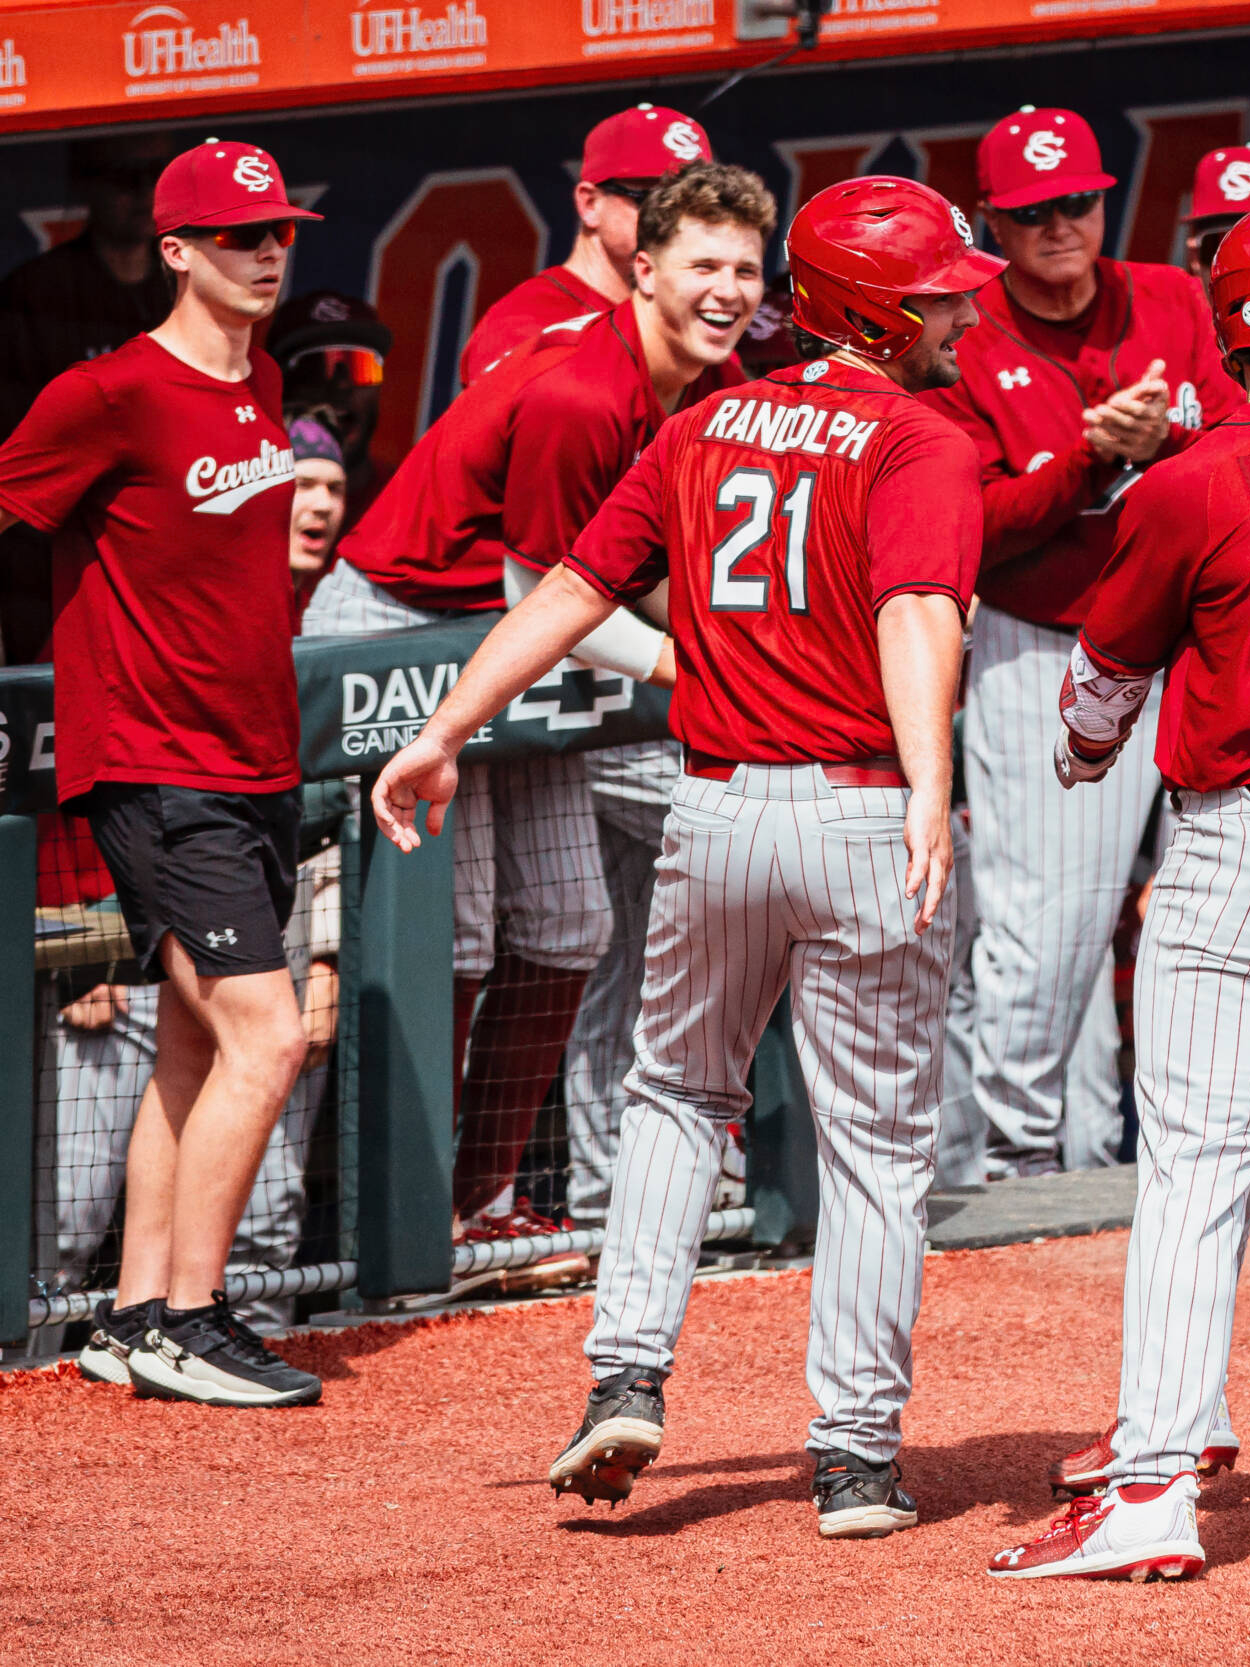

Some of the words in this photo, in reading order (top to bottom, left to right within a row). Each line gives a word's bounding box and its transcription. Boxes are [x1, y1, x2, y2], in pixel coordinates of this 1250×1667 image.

[704, 398, 880, 461] RANDOLPH
[185, 438, 295, 498] Carolin
[709, 466, 818, 616] 21
